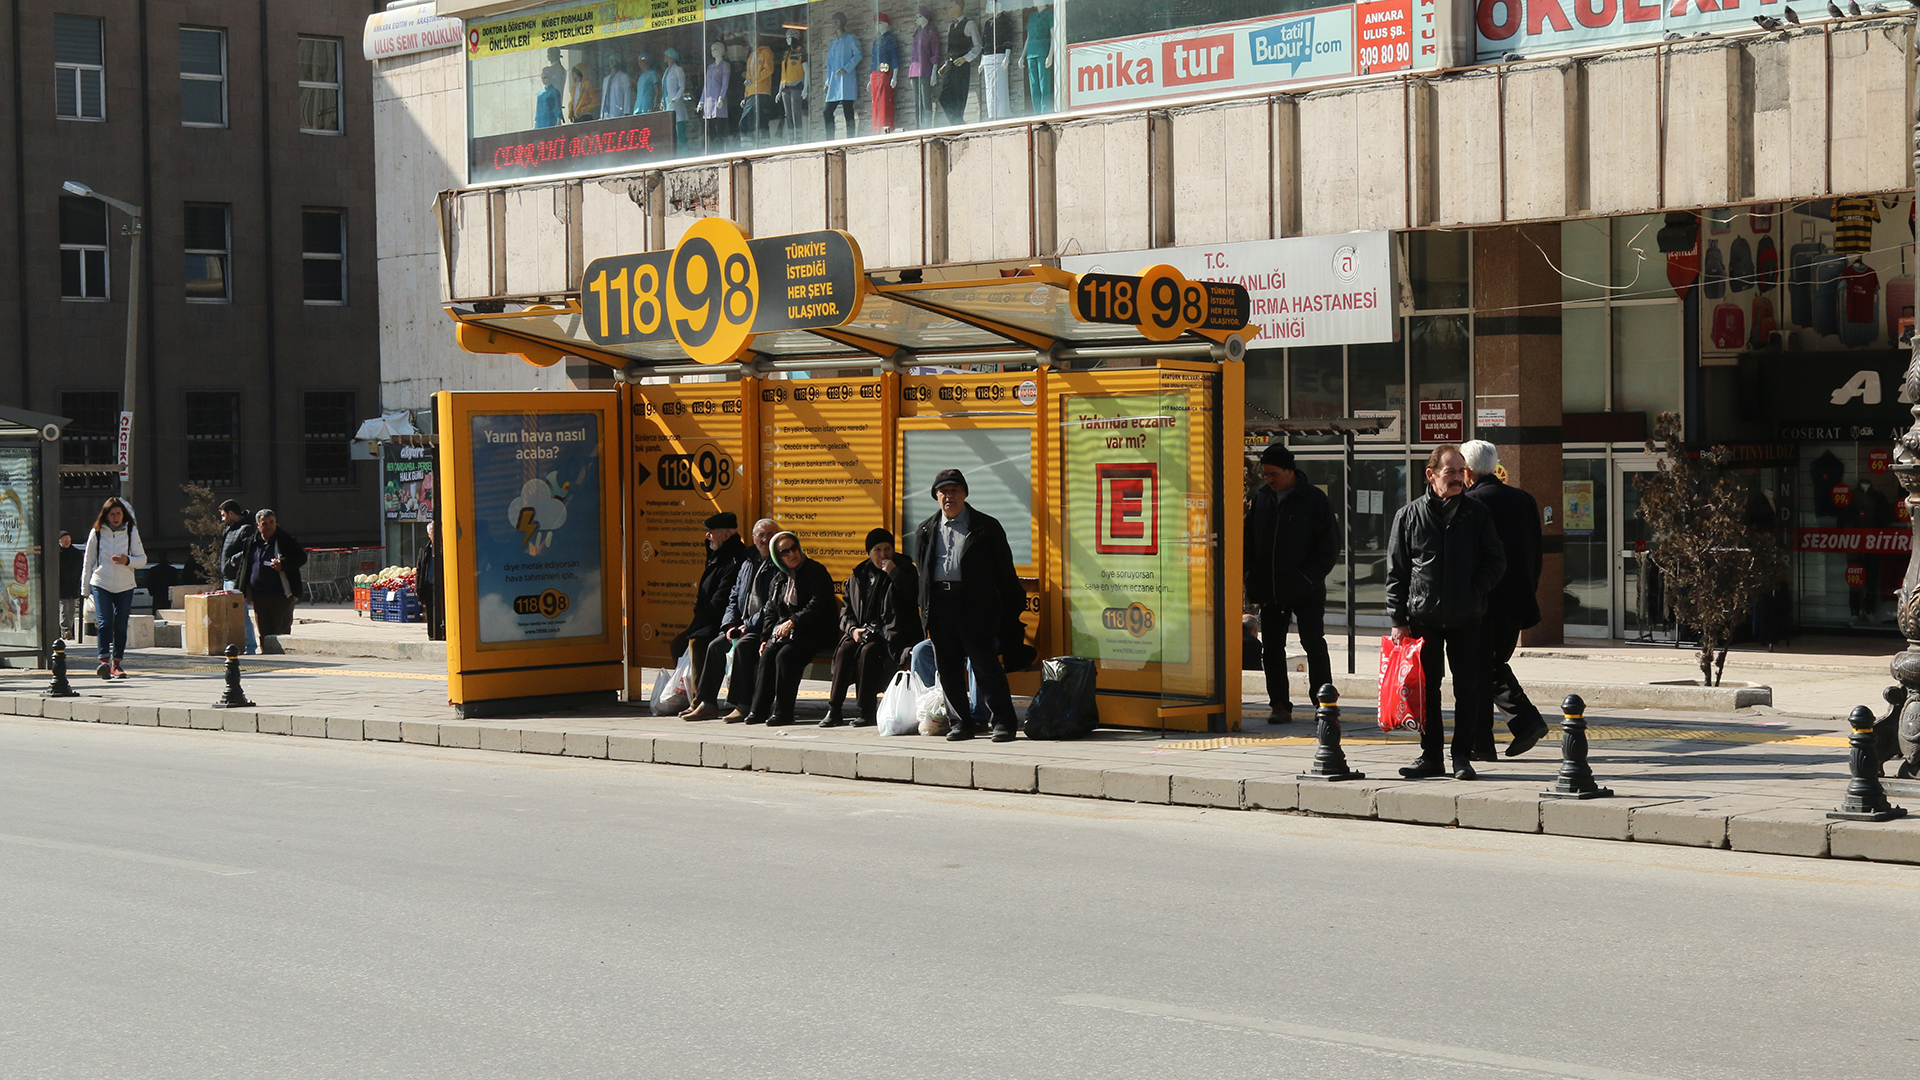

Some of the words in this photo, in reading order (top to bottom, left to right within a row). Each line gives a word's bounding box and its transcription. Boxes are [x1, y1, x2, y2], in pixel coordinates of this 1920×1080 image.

[599, 4, 616, 20] 112
[651, 2, 669, 10] TURİZM
[651, 10, 674, 19] ANADOLU
[677, 6, 697, 16] MESLEK
[541, 17, 560, 28] NÖBET
[560, 11, 594, 26] FORMALARI
[618, 16, 645, 31] SAĞLIK
[677, 14, 697, 24] MESLEK
[1364, 9, 1404, 24] ANKARA
[373, 24, 392, 34] ANKARA
[482, 26, 502, 36] DOKTOR
[504, 25, 508, 33] &
[508, 20, 536, 32] ÖĞRETMEN
[542, 31, 558, 42] SABO
[558, 24, 594, 40] TERLİKLER
[1280, 22, 1304, 42] tatil
[1364, 27, 1388, 40] ULUS
[1390, 26, 1406, 40] ŞB.
[374, 40, 395, 54] ULUS
[396, 33, 418, 52] SEMT
[489, 32, 530, 52] ÖNLÜKLERİ
[1360, 46, 1379, 66] 309
[1381, 44, 1394, 64] 80
[1396, 42, 1410, 62] 90
[1078, 51, 1154, 92] mika
[1173, 42, 1225, 80] tur
[785, 242, 826, 260] TÜRKİYE
[1204, 252, 1230, 270] T.C.
[786, 260, 826, 280] İSTEDİĞİ
[787, 286, 807, 300] HER
[808, 282, 833, 300] ŞEYE
[1210, 286, 1236, 296] TÜRKİYE
[1210, 296, 1235, 306] İSTEDİĞİ
[1292, 288, 1377, 313] HASTANESİ
[788, 302, 840, 320] ULAŞIYOR.
[1210, 307, 1222, 315] HER
[1223, 308, 1238, 316] ŞEYE
[1210, 317, 1241, 326] ULAŞIYOR.
[1078, 414, 1128, 430] Yakında
[1132, 415, 1176, 428] eczane
[484, 429, 518, 443] Yarın
[521, 429, 552, 442] hava
[556, 428, 586, 442] nasıl
[1106, 436, 1123, 449] var
[1126, 433, 1147, 449] mı?
[1782, 427, 1842, 440] COSERAT
[516, 446, 560, 460] acaba?
[827, 442, 850, 451] gelecek?
[1802, 533, 1861, 550] SEZONU
[504, 562, 520, 572] diye
[521, 562, 542, 570] merak
[544, 561, 580, 570] ediyorsan
[505, 574, 522, 582] hava
[524, 572, 560, 582] tahminleri
[1100, 570, 1116, 580] diye
[1116, 570, 1154, 580] soruyorsan
[1084, 583, 1100, 591] sana
[1101, 584, 1110, 592] en
[1130, 584, 1154, 592] eczane
